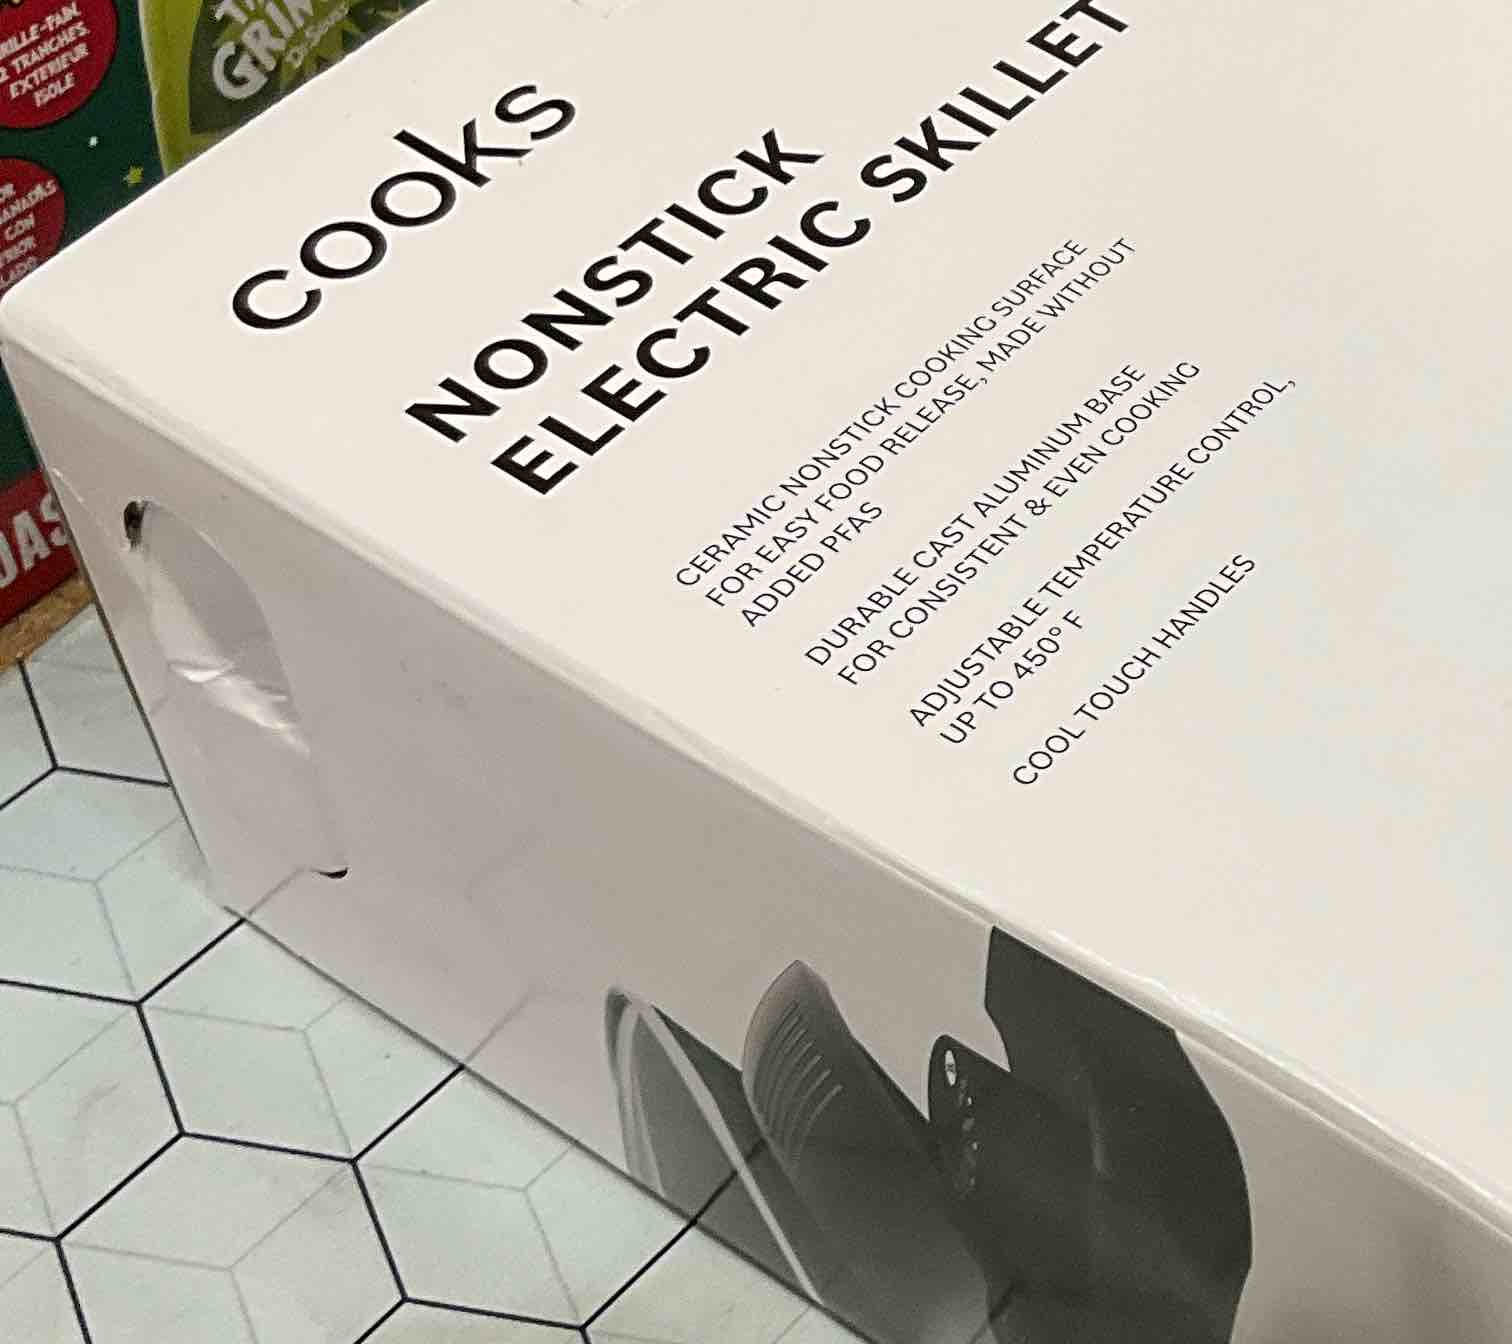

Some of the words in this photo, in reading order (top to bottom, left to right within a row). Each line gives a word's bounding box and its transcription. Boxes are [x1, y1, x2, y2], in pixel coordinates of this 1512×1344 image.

[232, 85, 576, 330] cooks
[404, 129, 823, 443] NONSTICK
[490, 201, 871, 495] ELECTRIC
[677, 495, 786, 586] CERAMIC
[779, 397, 901, 496] NONSTICK
[894, 316, 997, 398] COOKING
[992, 239, 1088, 317] SURFACE
[705, 563, 763, 607] FOR
[755, 508, 819, 563] EASY
[814, 455, 884, 512] FOOD
[879, 374, 988, 455] RELEASE,
[976, 317, 1046, 372] MADE
[1036, 237, 1136, 317] WITHOUT
[805, 568, 920, 666] DURABLE
[913, 513, 975, 568] CAST
[973, 413, 1092, 518] ALUMINUM
[1083, 364, 1146, 416] BASE
[837, 640, 895, 685] FOR
[889, 513, 1027, 639] CONSISTENT
[1024, 498, 1052, 516] &
[1043, 445, 1107, 498] EVEN
[1101, 361, 1200, 445] COOKING
[910, 598, 1048, 727] ADJUSTABLE
[1038, 463, 1194, 599] TEMPERATURE
[1187, 380, 1296, 463] CONTROL,
[742, 553, 824, 627] ADDED
[819, 502, 882, 553] PFAS
[940, 712, 976, 744] UP
[972, 681, 1013, 709] TO
[1014, 627, 1062, 680] 450°
[1062, 609, 1083, 630] F
[1013, 726, 1087, 785] COOL
[1072, 647, 1161, 721] TOUCH
[1152, 554, 1256, 648] HANDLES
